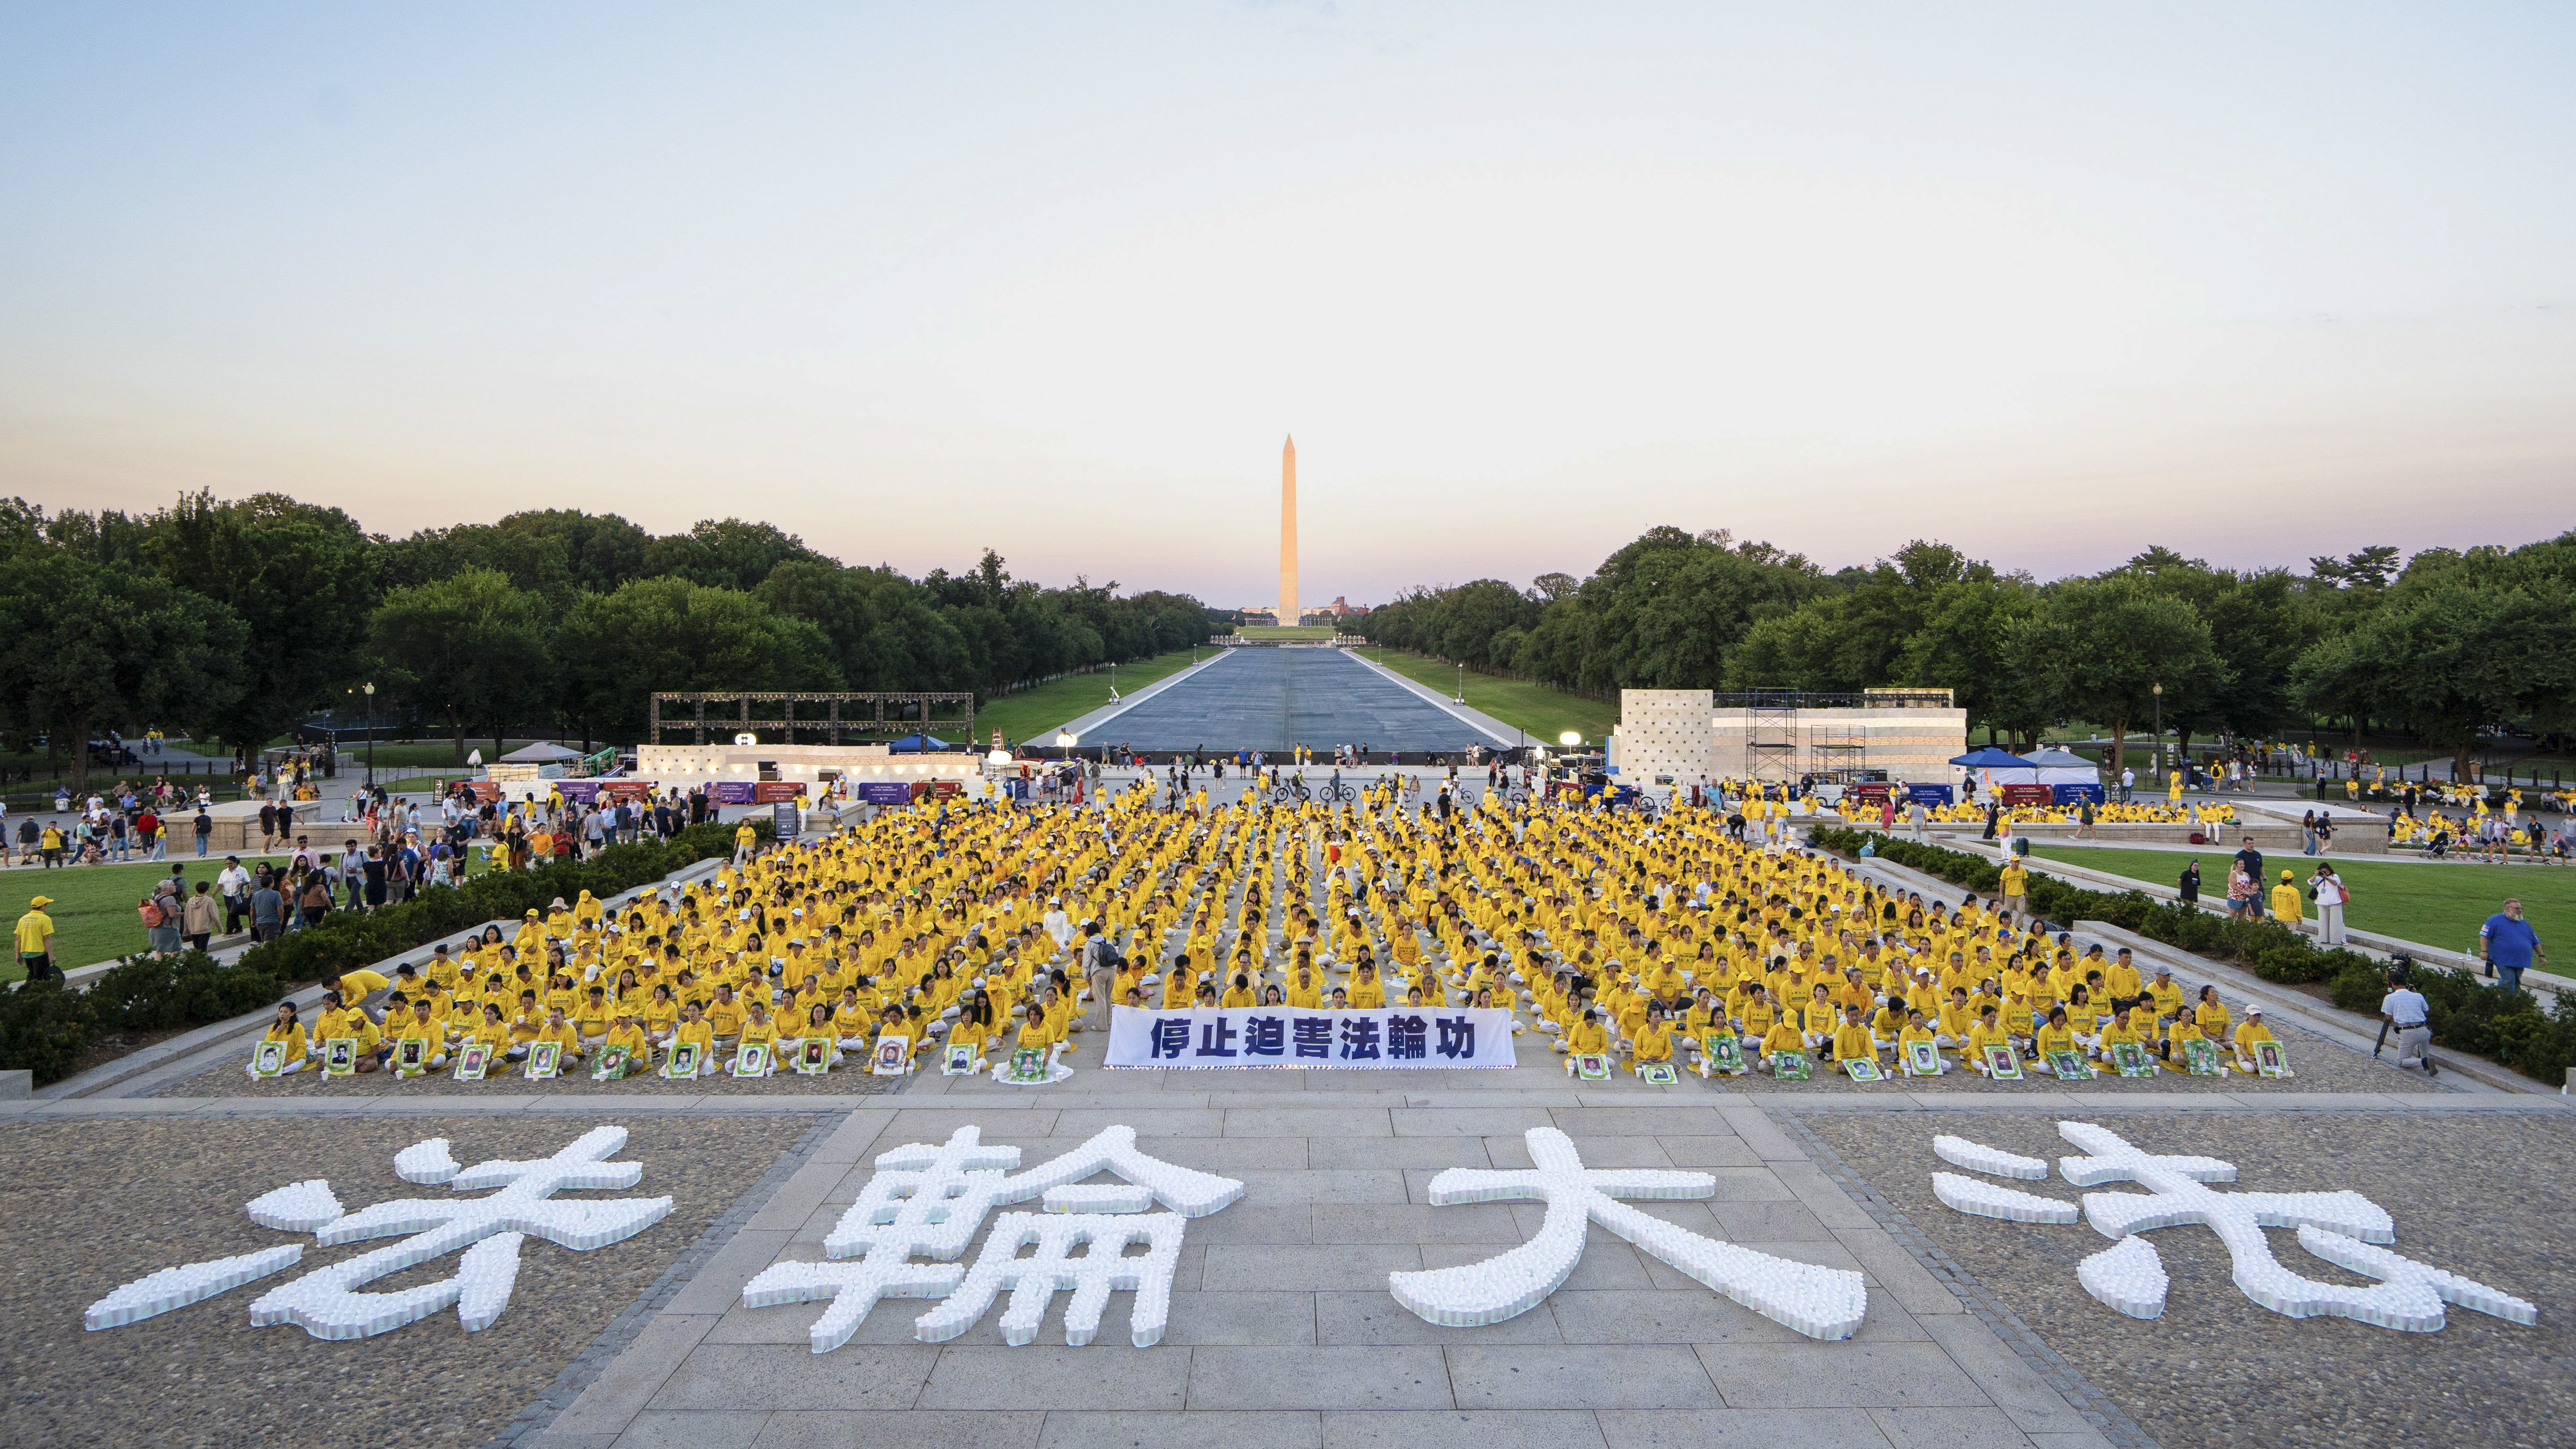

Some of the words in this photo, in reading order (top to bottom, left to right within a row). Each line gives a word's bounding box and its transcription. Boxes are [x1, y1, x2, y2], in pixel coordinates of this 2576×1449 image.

[1151, 1014, 1475, 1060] 停止迫害法輪功
